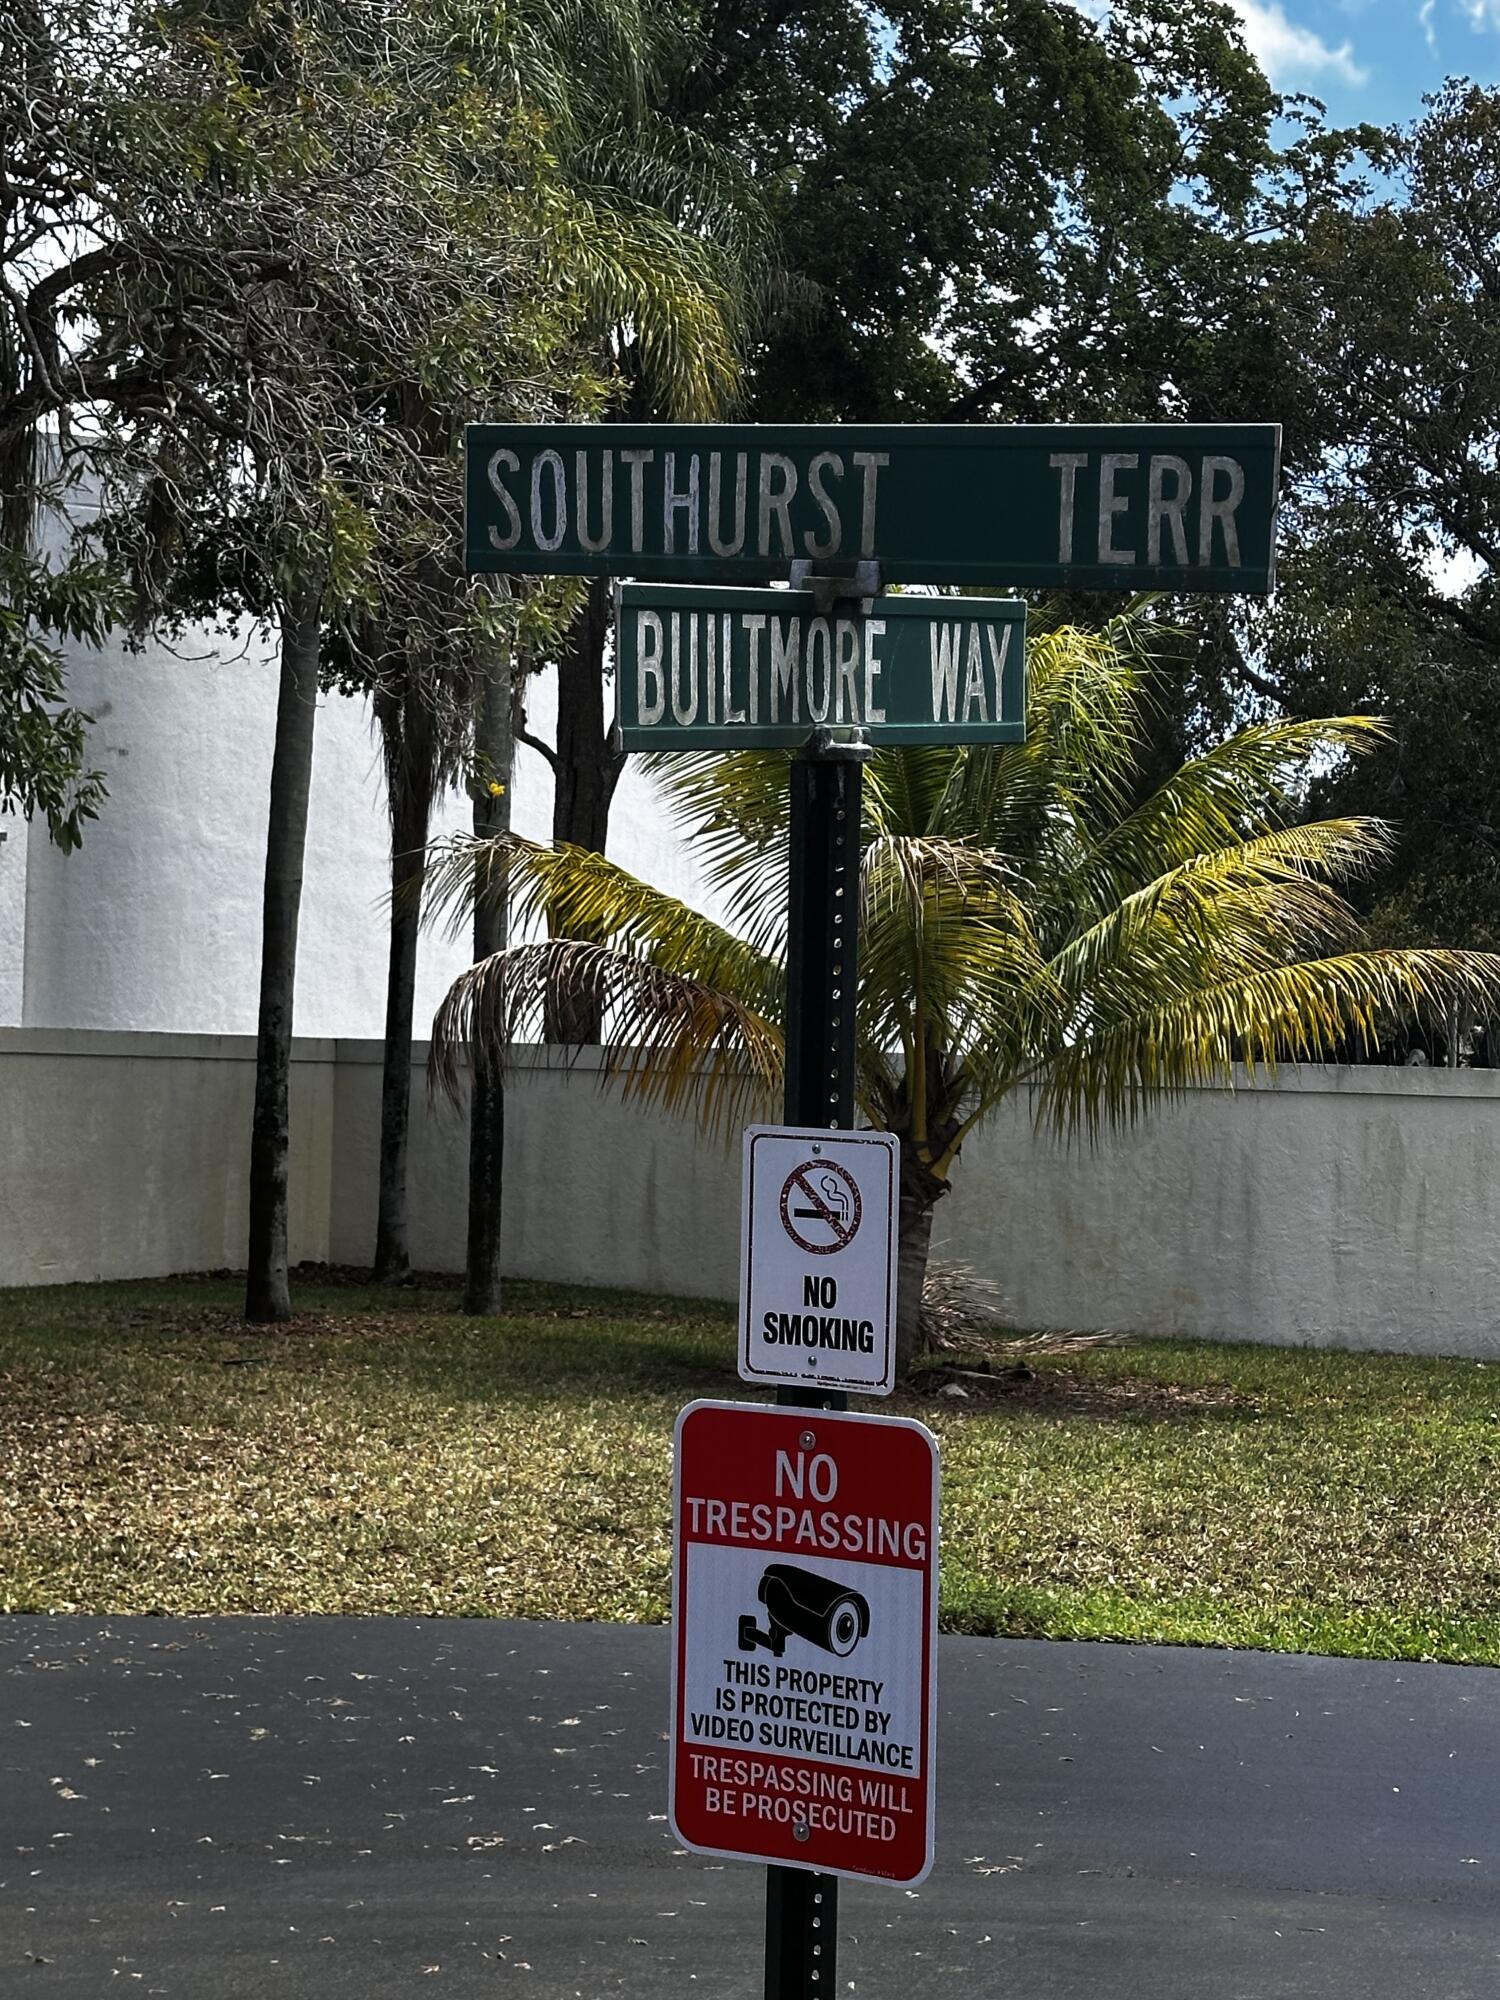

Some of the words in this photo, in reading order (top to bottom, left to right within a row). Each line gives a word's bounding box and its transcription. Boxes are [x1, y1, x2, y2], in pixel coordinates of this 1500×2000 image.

[487, 448, 890, 558] SOUTHURST
[1049, 453, 1245, 567] TERR
[636, 610, 887, 726] BUILTMORE
[929, 622, 1013, 724] WAY
[803, 1275, 837, 1310] NO
[762, 1311, 874, 1354] SMOKING
[775, 1449, 839, 1503] NO
[686, 1497, 927, 1561] TRESPASSING
[723, 1659, 771, 1688] THIS
[775, 1666, 885, 1705] PROPERTY
[715, 1687, 737, 1712] IS
[740, 1690, 860, 1731] PROTECTED
[864, 1707, 892, 1737] BY
[691, 1712, 755, 1744] VIDEO
[759, 1721, 914, 1770] SURVEILLANCE
[689, 1754, 853, 1803] TRESPASSING
[858, 1780, 913, 1814] WILL
[705, 1786, 737, 1817] BE
[742, 1792, 897, 1842] PROSECUTED
